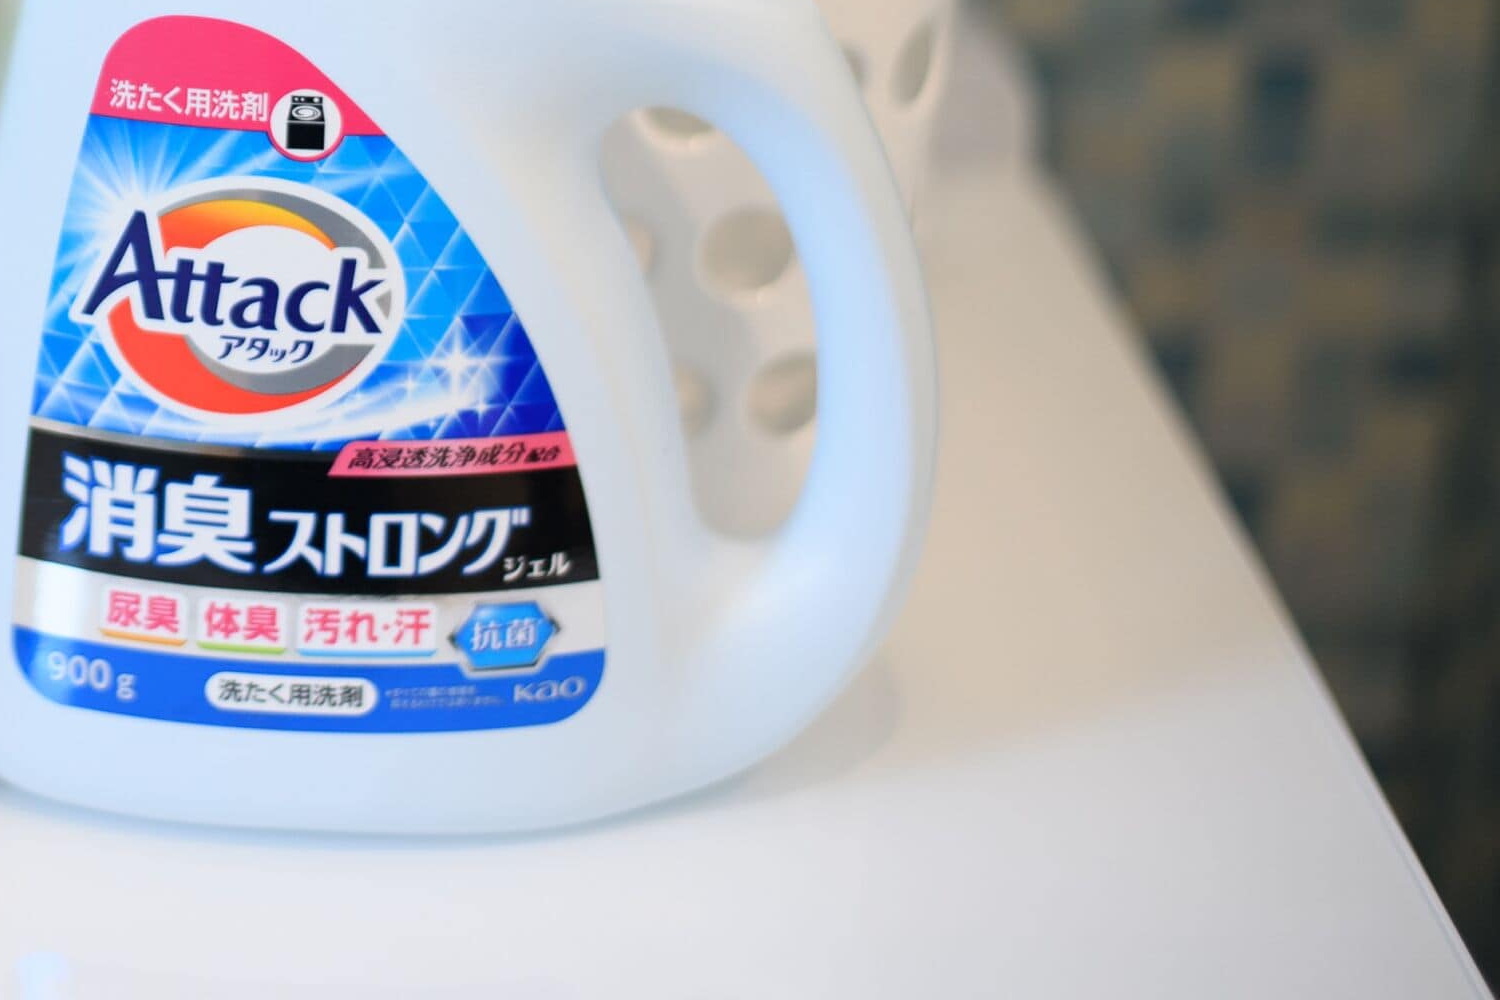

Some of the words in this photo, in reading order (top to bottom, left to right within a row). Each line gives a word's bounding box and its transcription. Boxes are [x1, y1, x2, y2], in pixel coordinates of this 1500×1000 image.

[109, 78, 269, 121] 洗たく用洗剤
[82, 209, 387, 335] Attack
[217, 335, 315, 363] アタック
[503, 553, 571, 582] ジェル
[106, 591, 181, 633] 尿臭
[204, 602, 281, 643] 体臭
[471, 618, 538, 651] 抗菌
[49, 652, 110, 690] 900
[116, 672, 135, 698] g
[218, 677, 364, 707] 洗たく用洗剤
